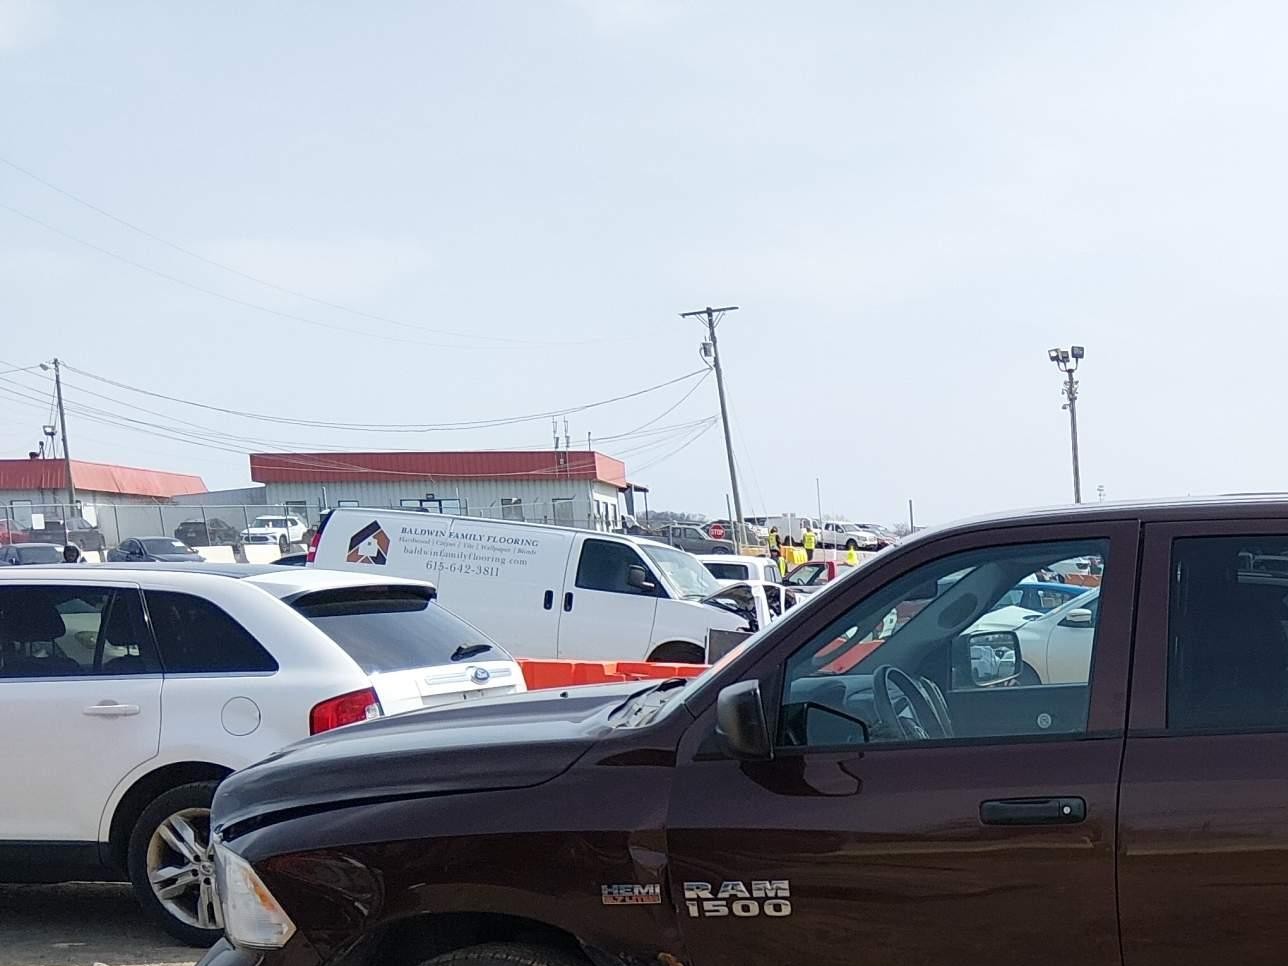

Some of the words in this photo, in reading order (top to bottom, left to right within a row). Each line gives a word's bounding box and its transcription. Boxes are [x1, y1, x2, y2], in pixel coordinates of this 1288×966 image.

[400, 526, 447, 538] BALDWIN
[448, 530, 486, 542] FAMILY
[486, 535, 540, 548] FLOORING
[403, 546, 528, 566] baldwinfamilyflooring.com
[425, 559, 500, 577] 615-642-3811
[601, 884, 661, 897] HEMI
[683, 879, 791, 899] RAM
[685, 899, 792, 918] 1500
